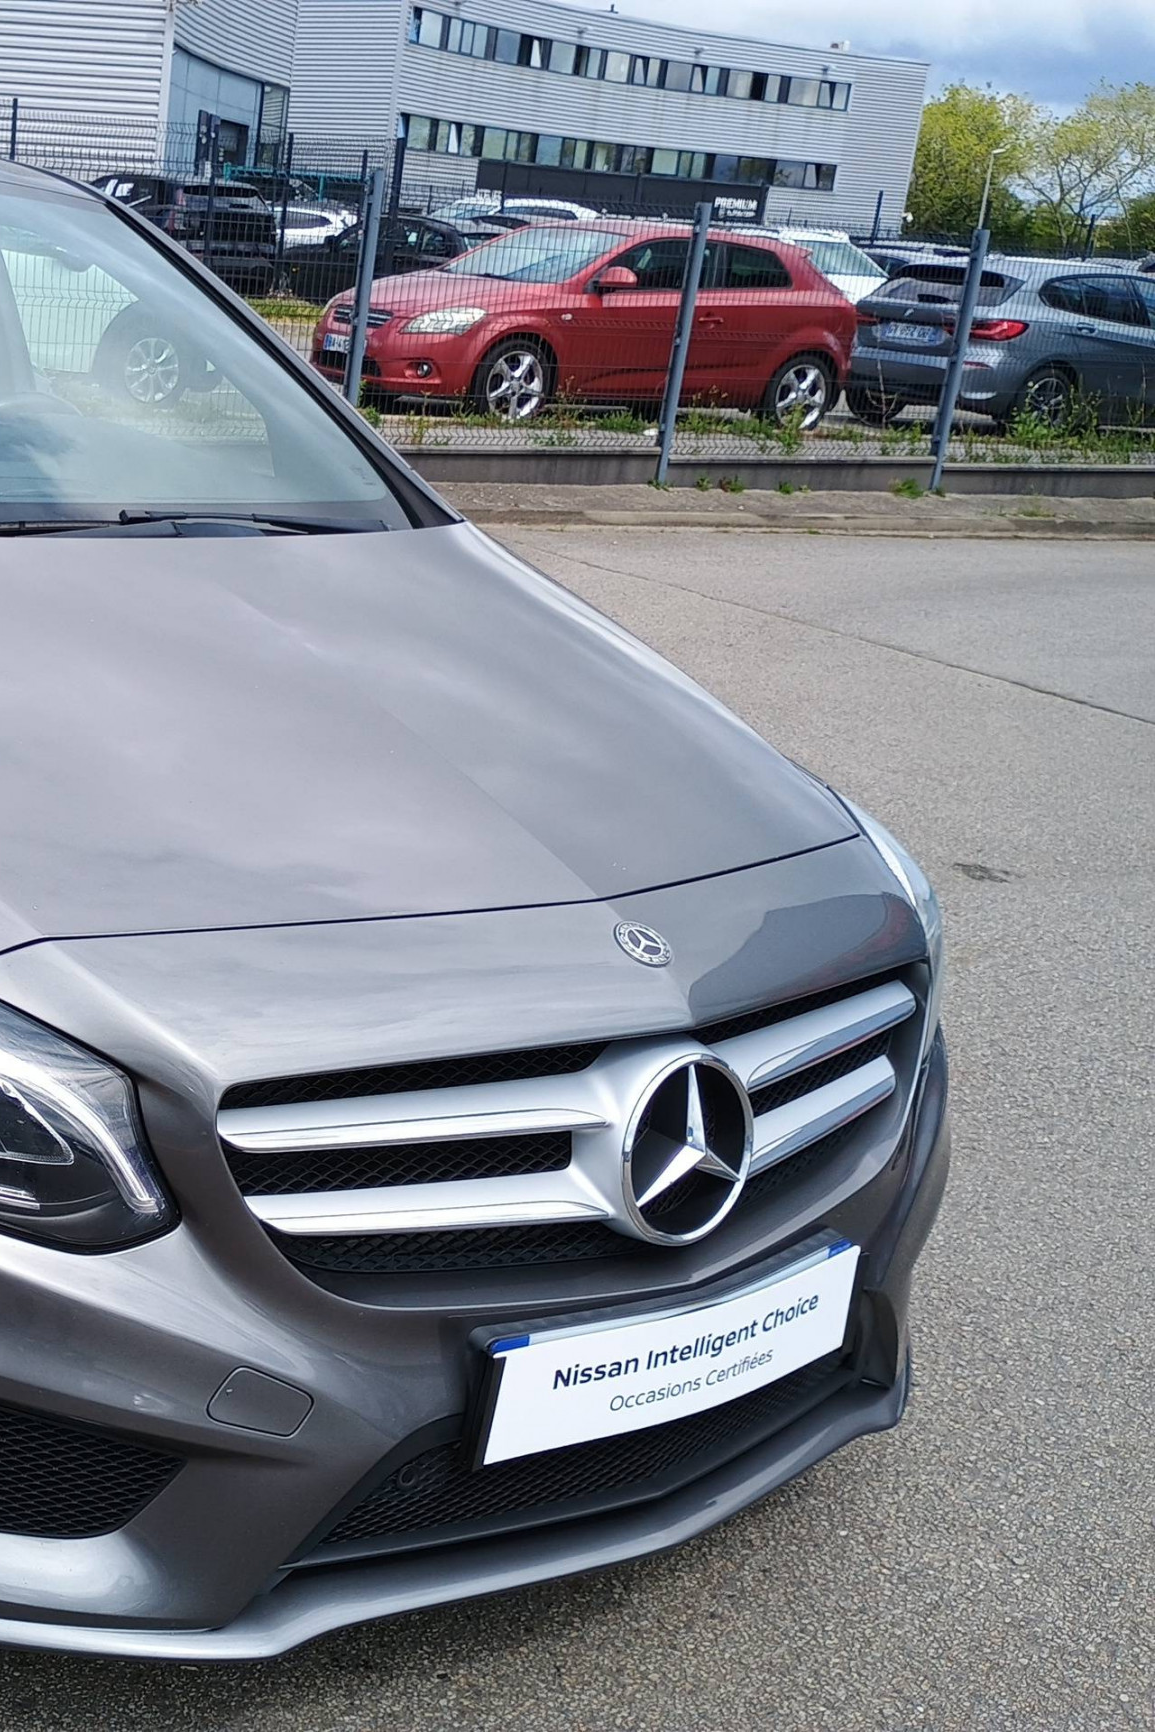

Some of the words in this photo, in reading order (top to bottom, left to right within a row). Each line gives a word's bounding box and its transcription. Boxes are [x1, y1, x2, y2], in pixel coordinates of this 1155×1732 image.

[714, 196, 758, 211] PREMIUM
[552, 1357, 639, 1390] Nissan
[646, 1320, 758, 1370] Intelligent
[762, 1294, 819, 1333] Choice
[609, 1377, 701, 1412] Occasions
[705, 1349, 774, 1386] Certifiées
